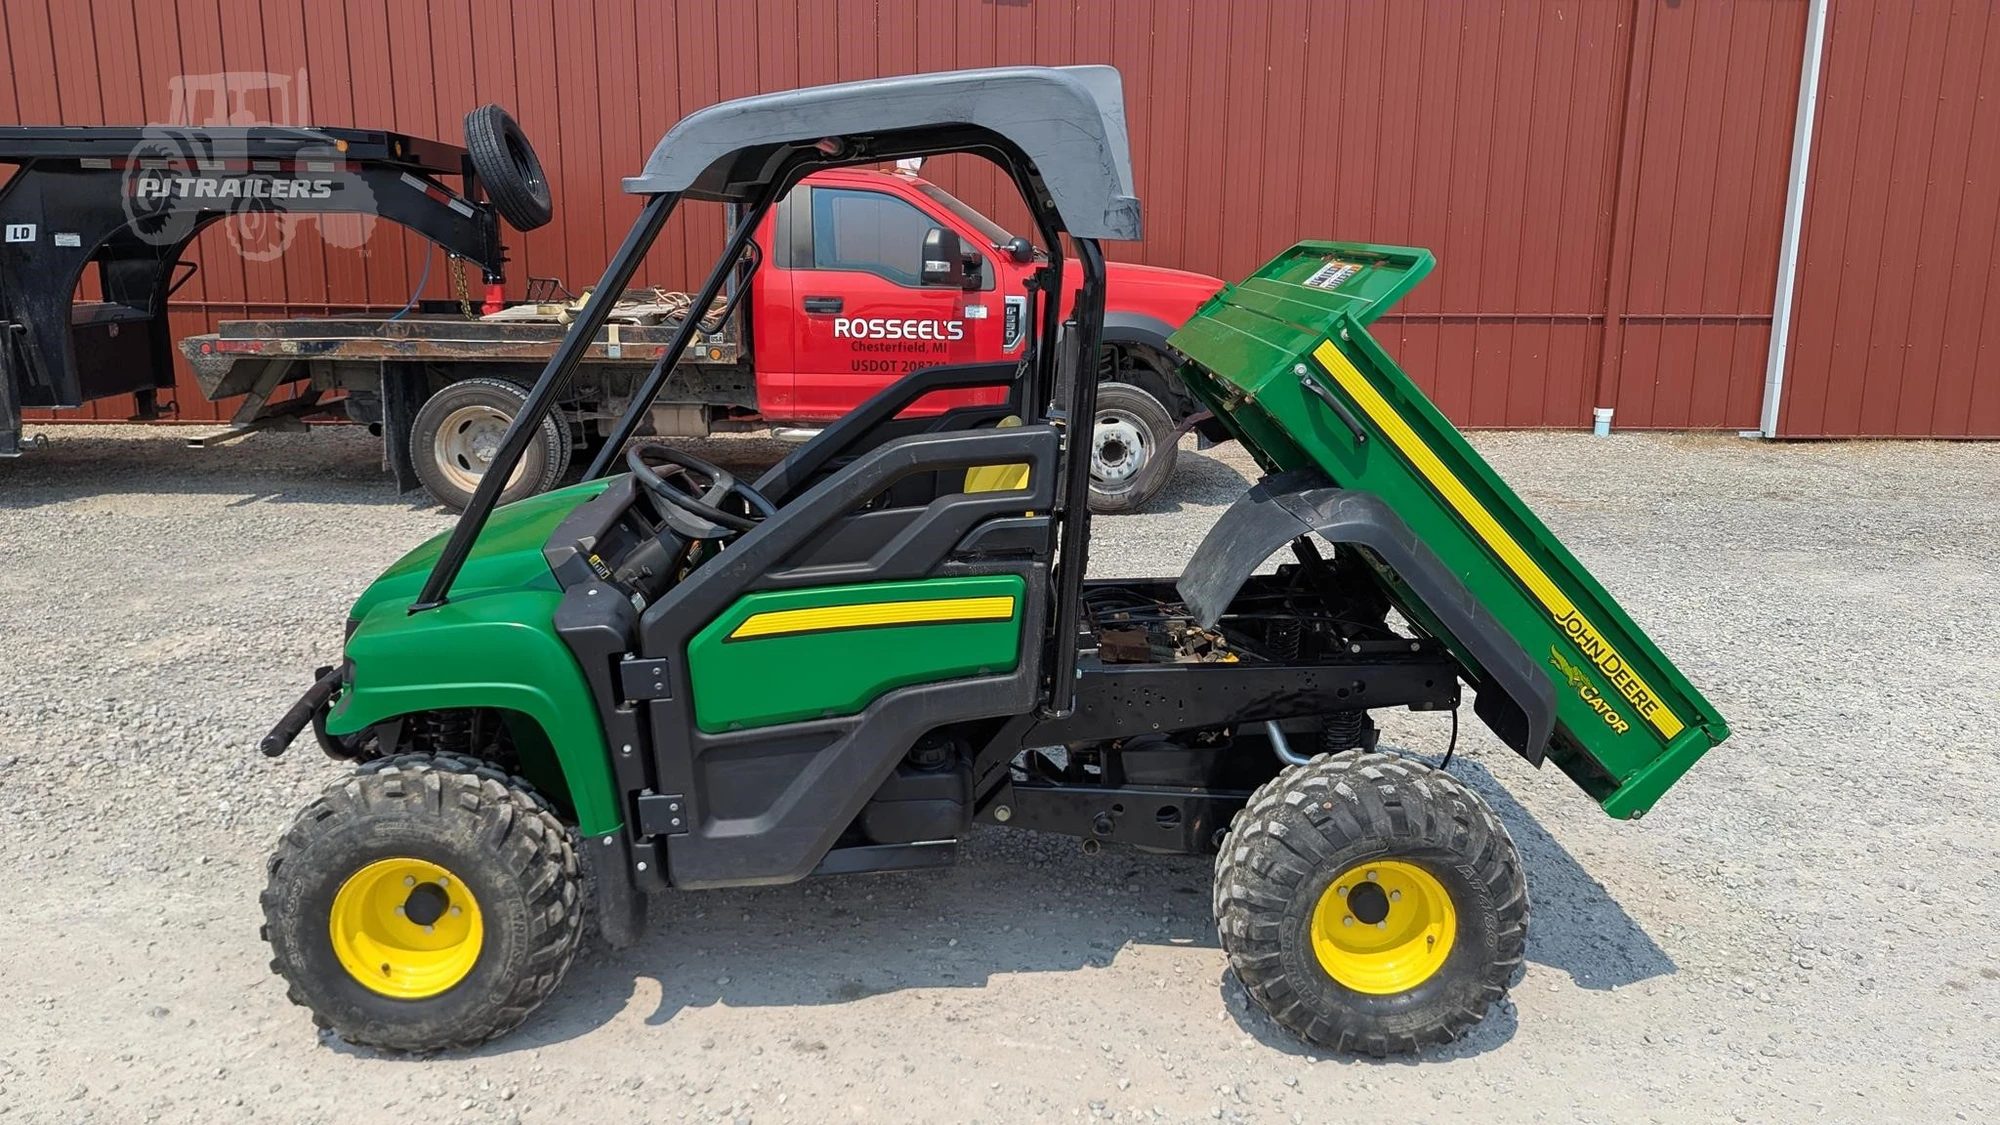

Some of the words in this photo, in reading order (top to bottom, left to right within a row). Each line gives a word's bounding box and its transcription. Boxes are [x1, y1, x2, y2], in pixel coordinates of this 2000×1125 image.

[137, 178, 172, 198] PJ
[175, 178, 332, 199] TRAILERS
[13, 227, 30, 240] LD
[834, 318, 964, 340] ROSSEEL'S
[851, 341, 929, 354] Chesterfield,
[932, 343, 947, 353] MI
[851, 360, 897, 373] USDOT
[1555, 610, 1606, 661] JOHN
[1601, 653, 1659, 718] DEERE
[1580, 686, 1629, 734] GATOR
